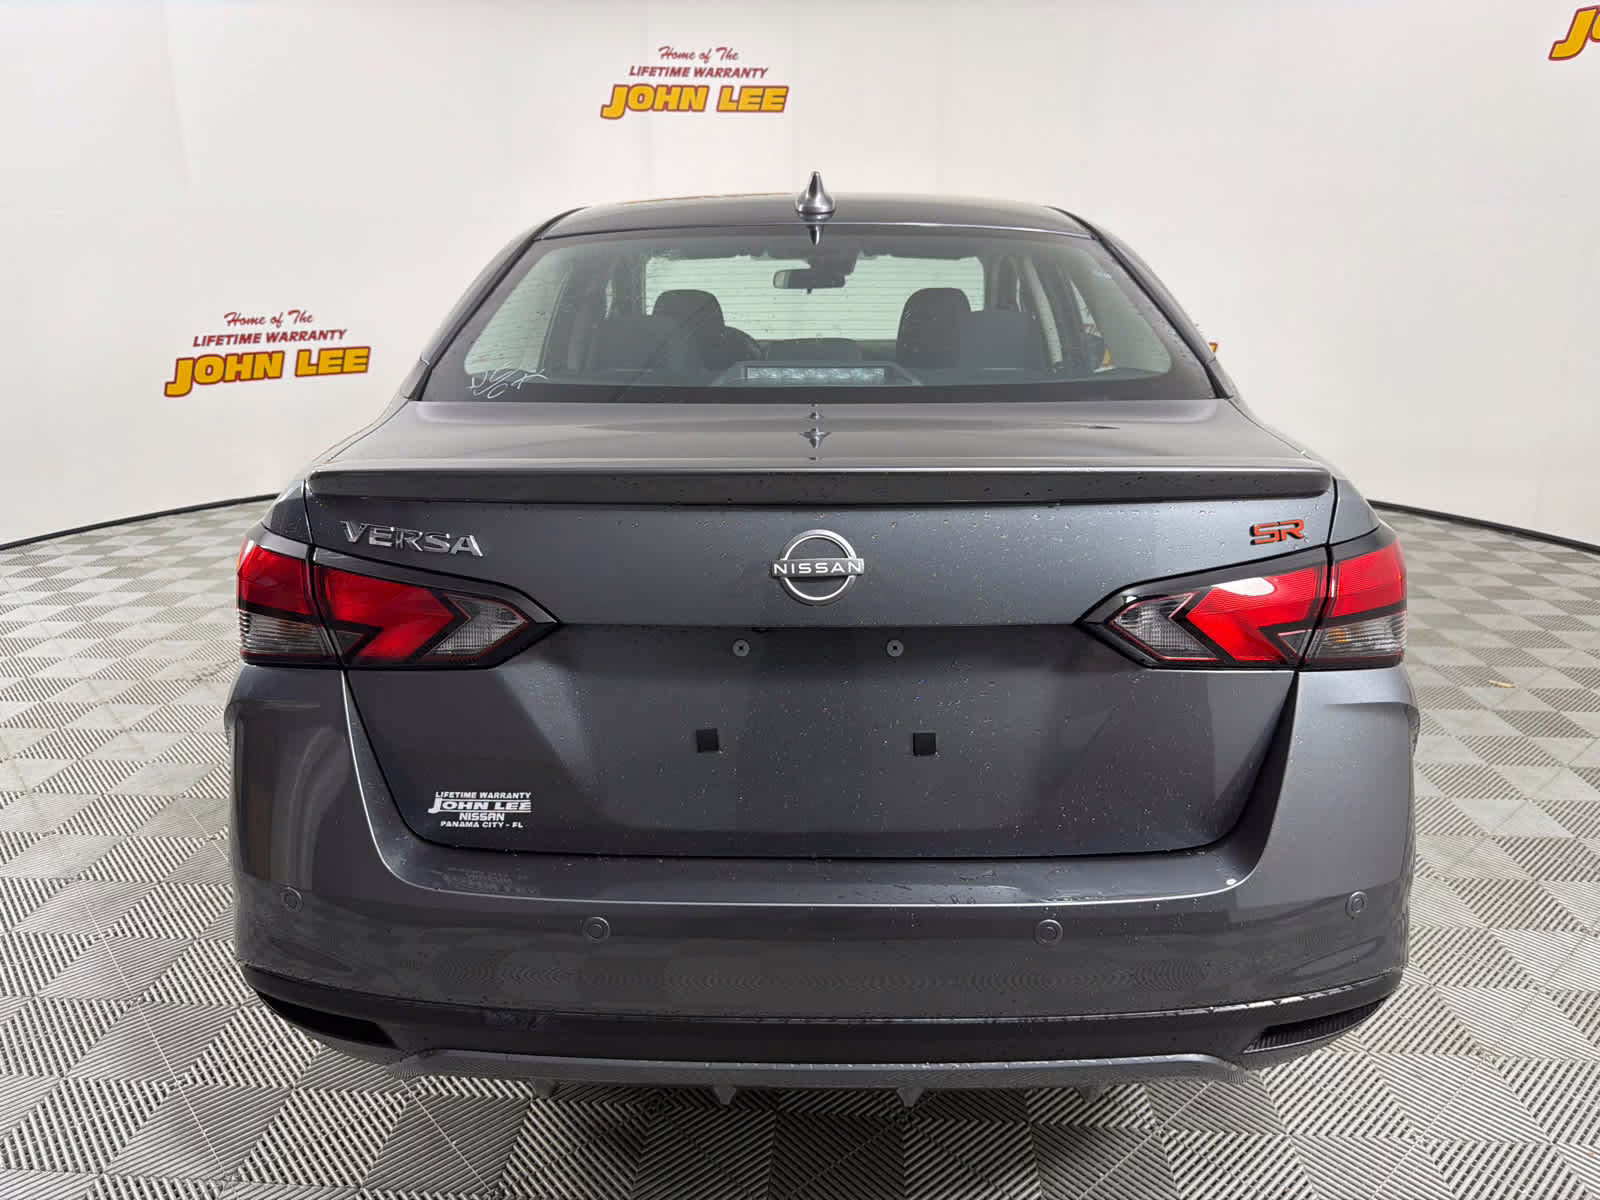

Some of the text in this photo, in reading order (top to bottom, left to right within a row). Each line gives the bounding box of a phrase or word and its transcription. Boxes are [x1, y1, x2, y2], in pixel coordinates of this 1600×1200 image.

[658, 46, 739, 64] Home of The
[628, 65, 769, 79] LIFETIME WARRANTY
[600, 84, 789, 119] JOHN LEE
[224, 310, 313, 328] Home of The
[193, 329, 347, 347] LIFETIME WARRANTY
[164, 346, 371, 397] JOHN LEE
[340, 520, 484, 557] VERSA
[1249, 519, 1304, 545] SR
[773, 561, 862, 574] NISSAN
[435, 791, 531, 799] LIFETIME WARRANTY
[427, 797, 531, 814] JOHN LEE
[459, 812, 505, 821] NISSAN
